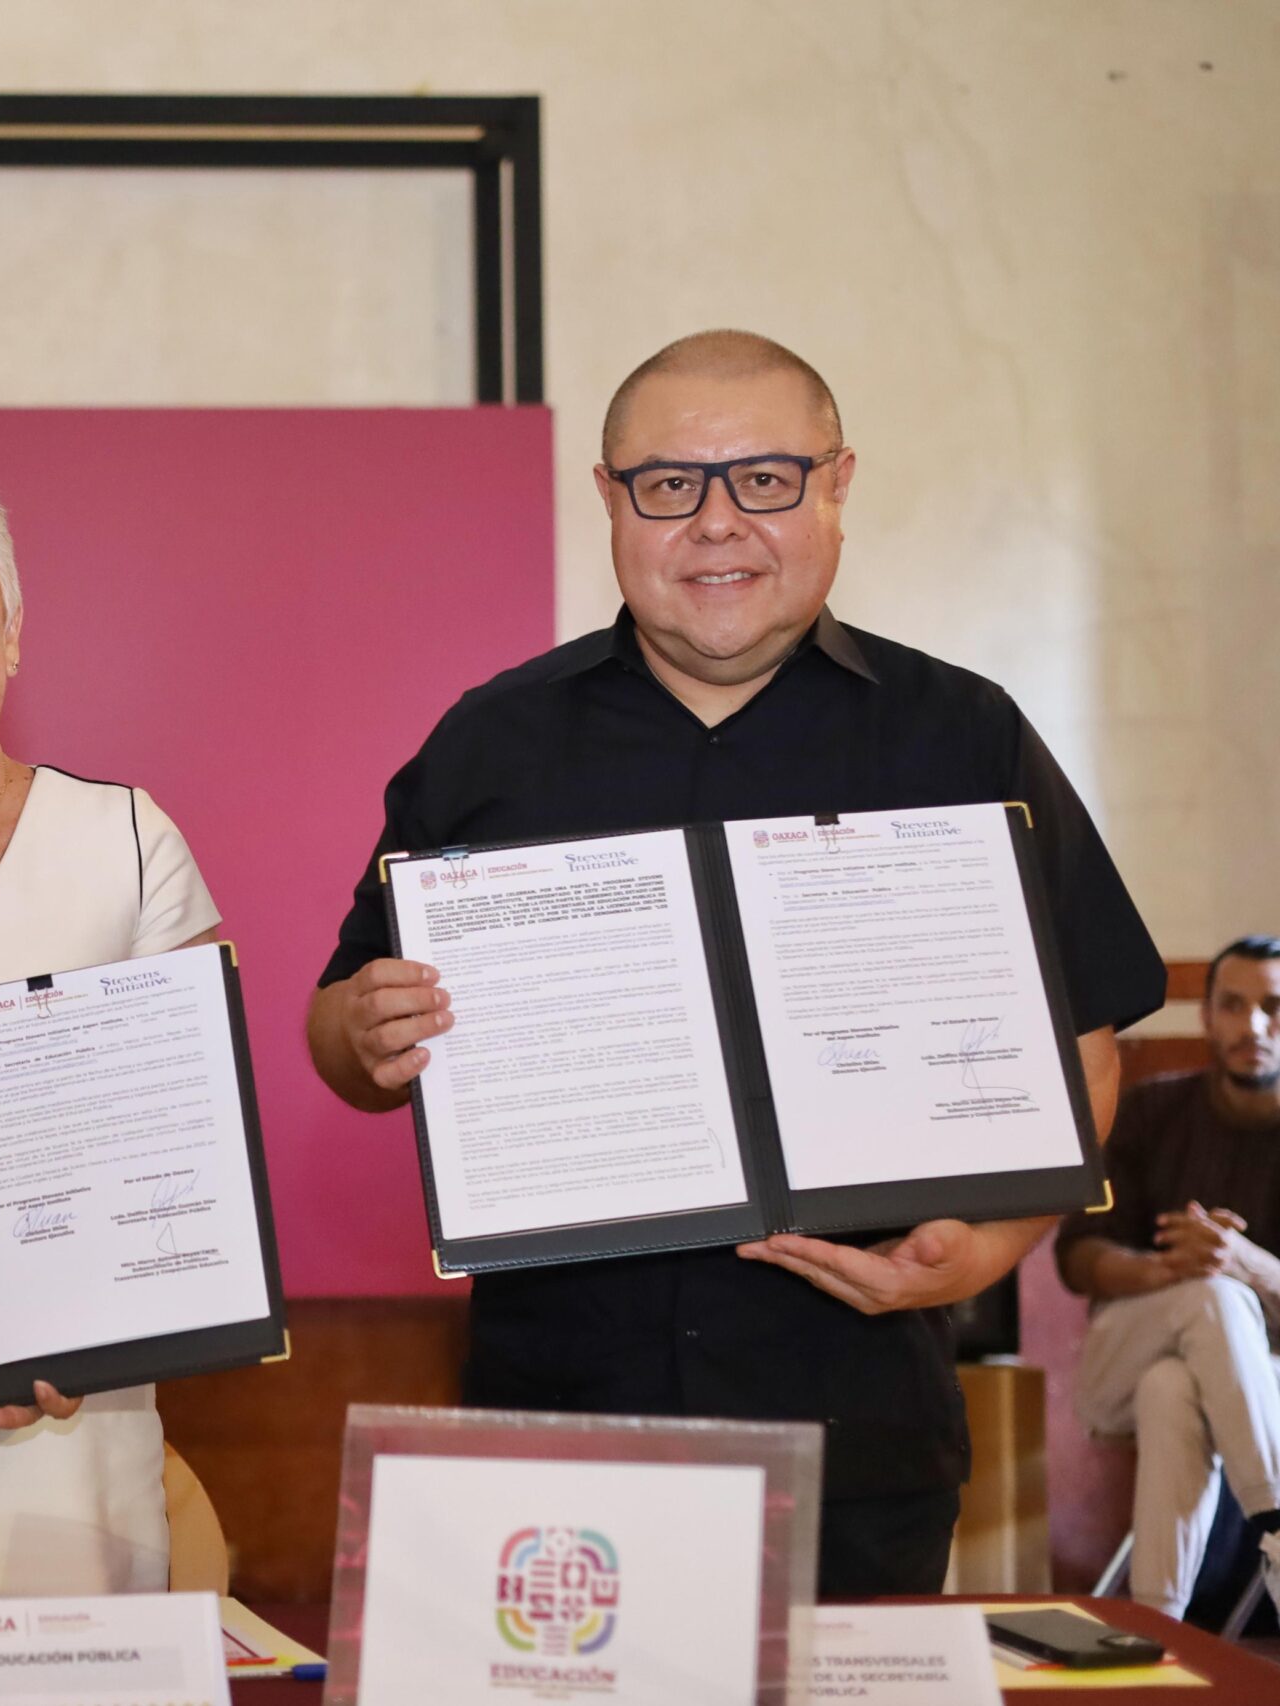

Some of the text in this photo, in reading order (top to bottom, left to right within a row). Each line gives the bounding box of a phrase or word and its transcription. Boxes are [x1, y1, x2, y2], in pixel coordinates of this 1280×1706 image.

[891, 820, 949, 830] Stevens
[772, 832, 808, 841] OAXACA
[895, 827, 961, 839] Initiative
[565, 850, 626, 863] Stevens
[568, 856, 639, 872] Initiative
[440, 870, 477, 880] OAXACA
[488, 863, 527, 873] EDUCACIÓN
[100, 970, 160, 987] Stevens
[103, 976, 172, 996] Initiative
[25, 991, 63, 1003] EDUCACIÓN
[13, 1197, 40, 1205] Programa
[47, 1197, 71, 1205] Institute
[77, 1648, 140, 1663] PÚBLICA
[827, 1656, 946, 1666] TRANSVERSALES
[489, 1663, 616, 1683] EDUCACIÓN
[814, 1671, 949, 1682] DE LA SECRETARÍA
